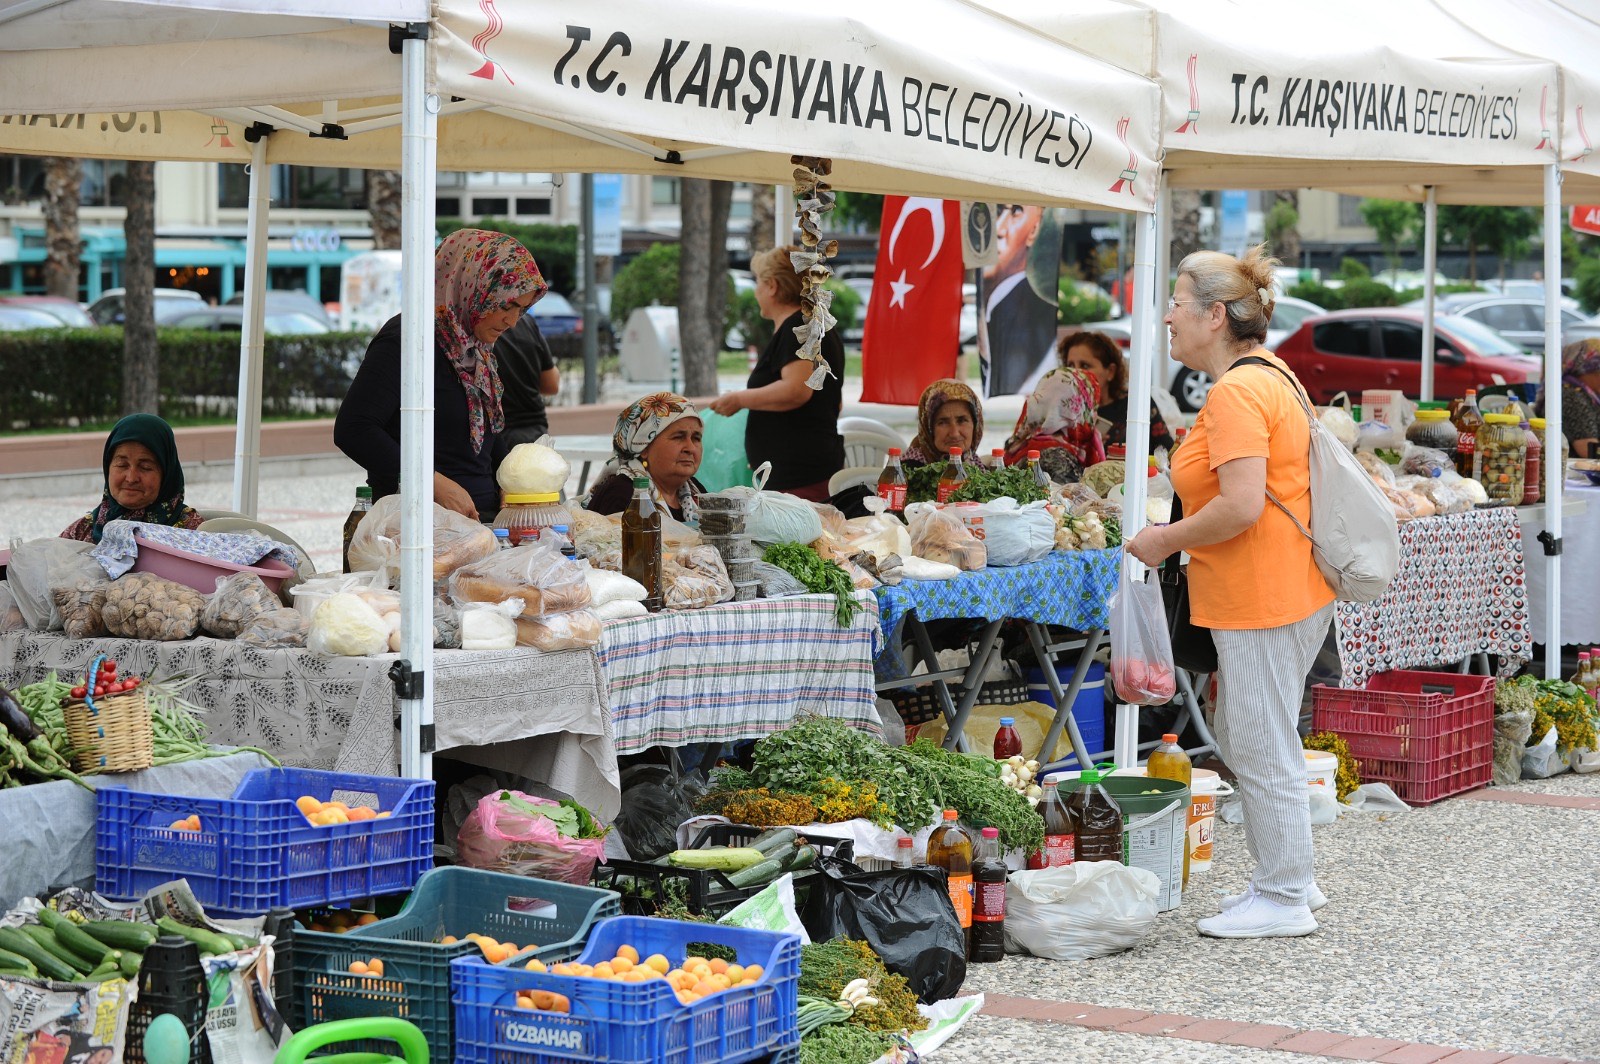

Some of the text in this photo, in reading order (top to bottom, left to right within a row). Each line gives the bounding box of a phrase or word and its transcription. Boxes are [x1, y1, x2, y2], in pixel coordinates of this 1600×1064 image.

[553, 25, 1093, 170] T.C. KARŞIYAKA BELEDİYESİ
[1231, 73, 1522, 140] T.C. KARŞIYAKA BELEDİYESİ
[506, 1020, 583, 1050] ÖZBAHAR
